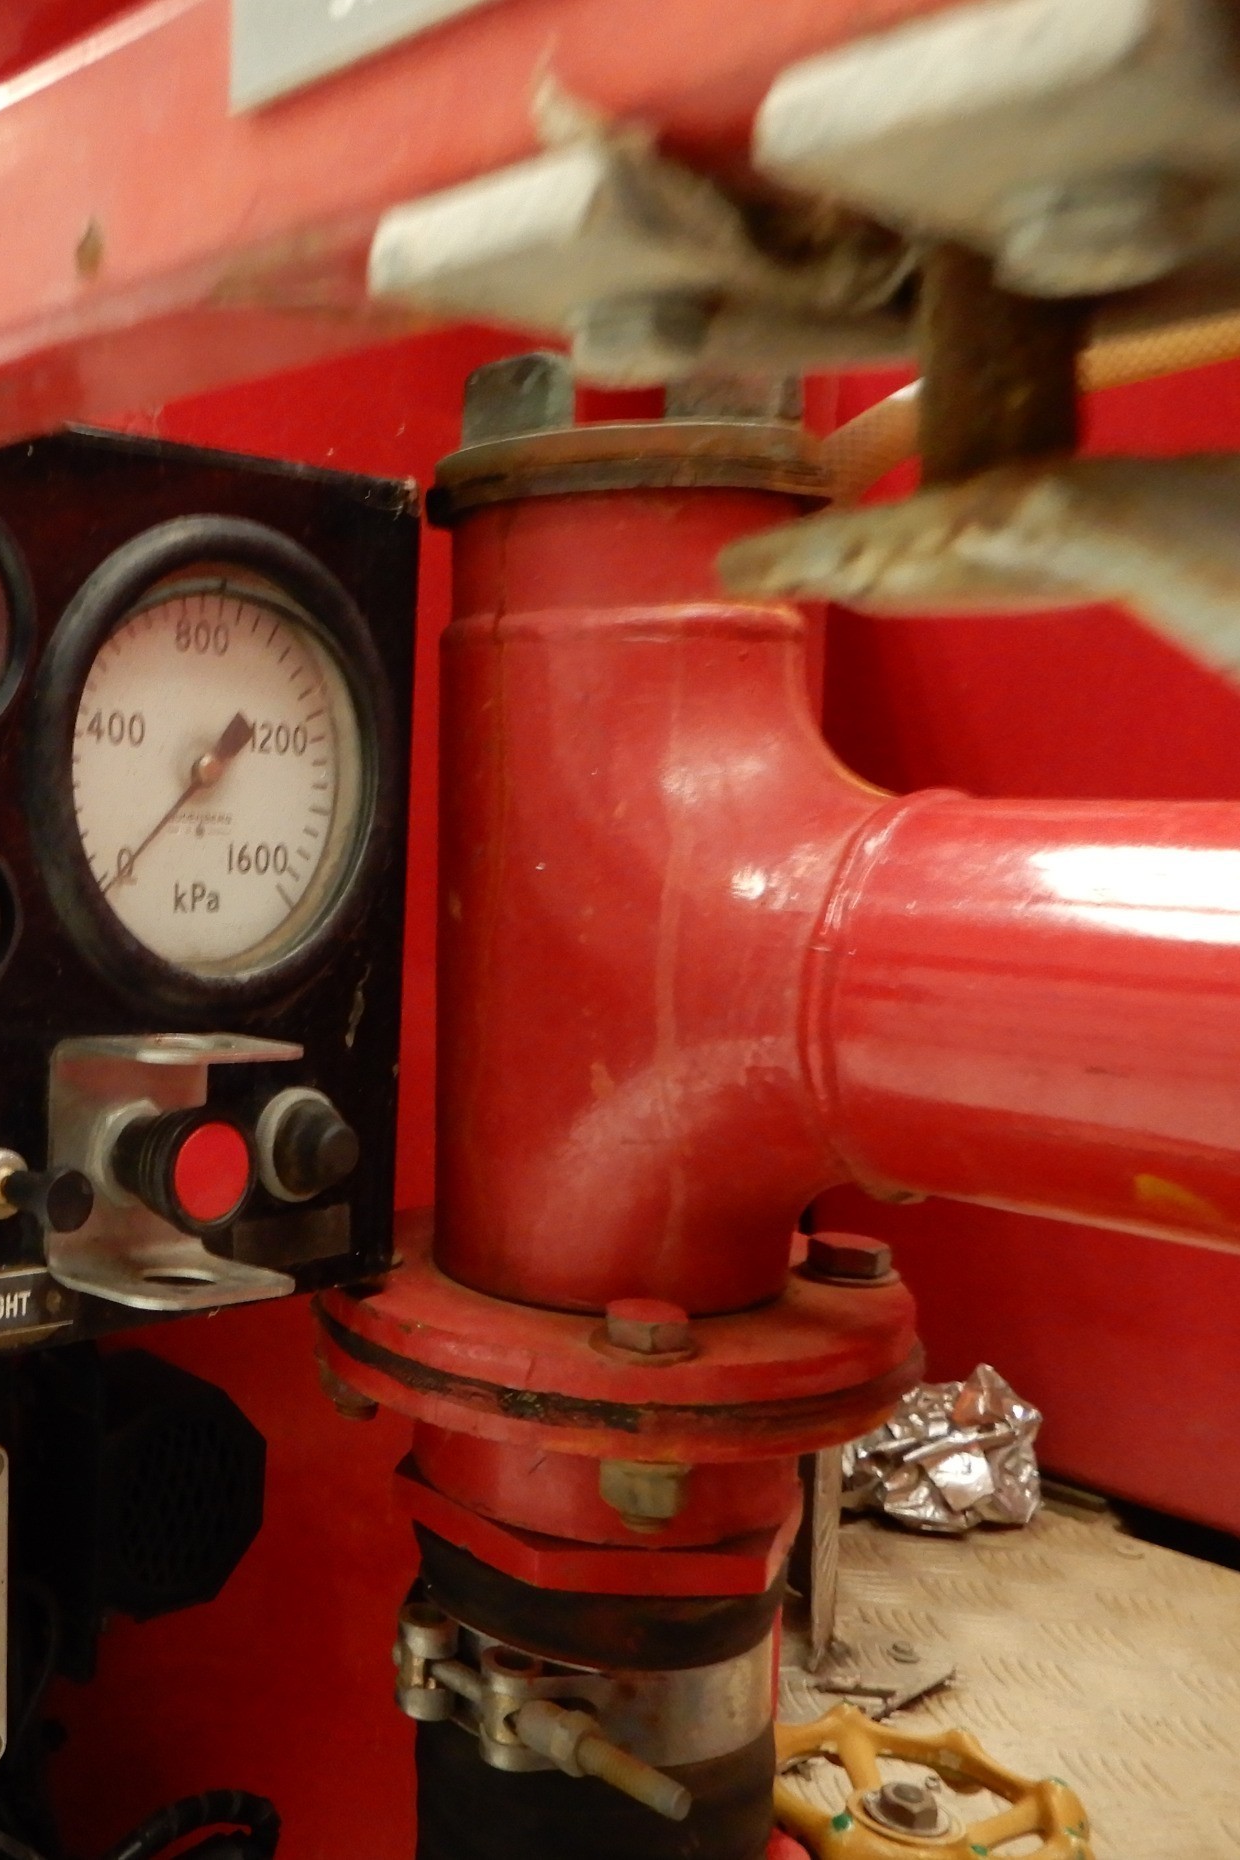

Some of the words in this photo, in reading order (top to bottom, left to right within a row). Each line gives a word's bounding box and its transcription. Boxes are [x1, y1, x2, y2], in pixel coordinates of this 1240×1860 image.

[174, 618, 230, 656] 800
[86, 708, 145, 747] 400
[250, 720, 308, 756] 1200
[116, 846, 134, 880] 0
[226, 842, 289, 876] 1600
[173, 880, 220, 914] kPa
